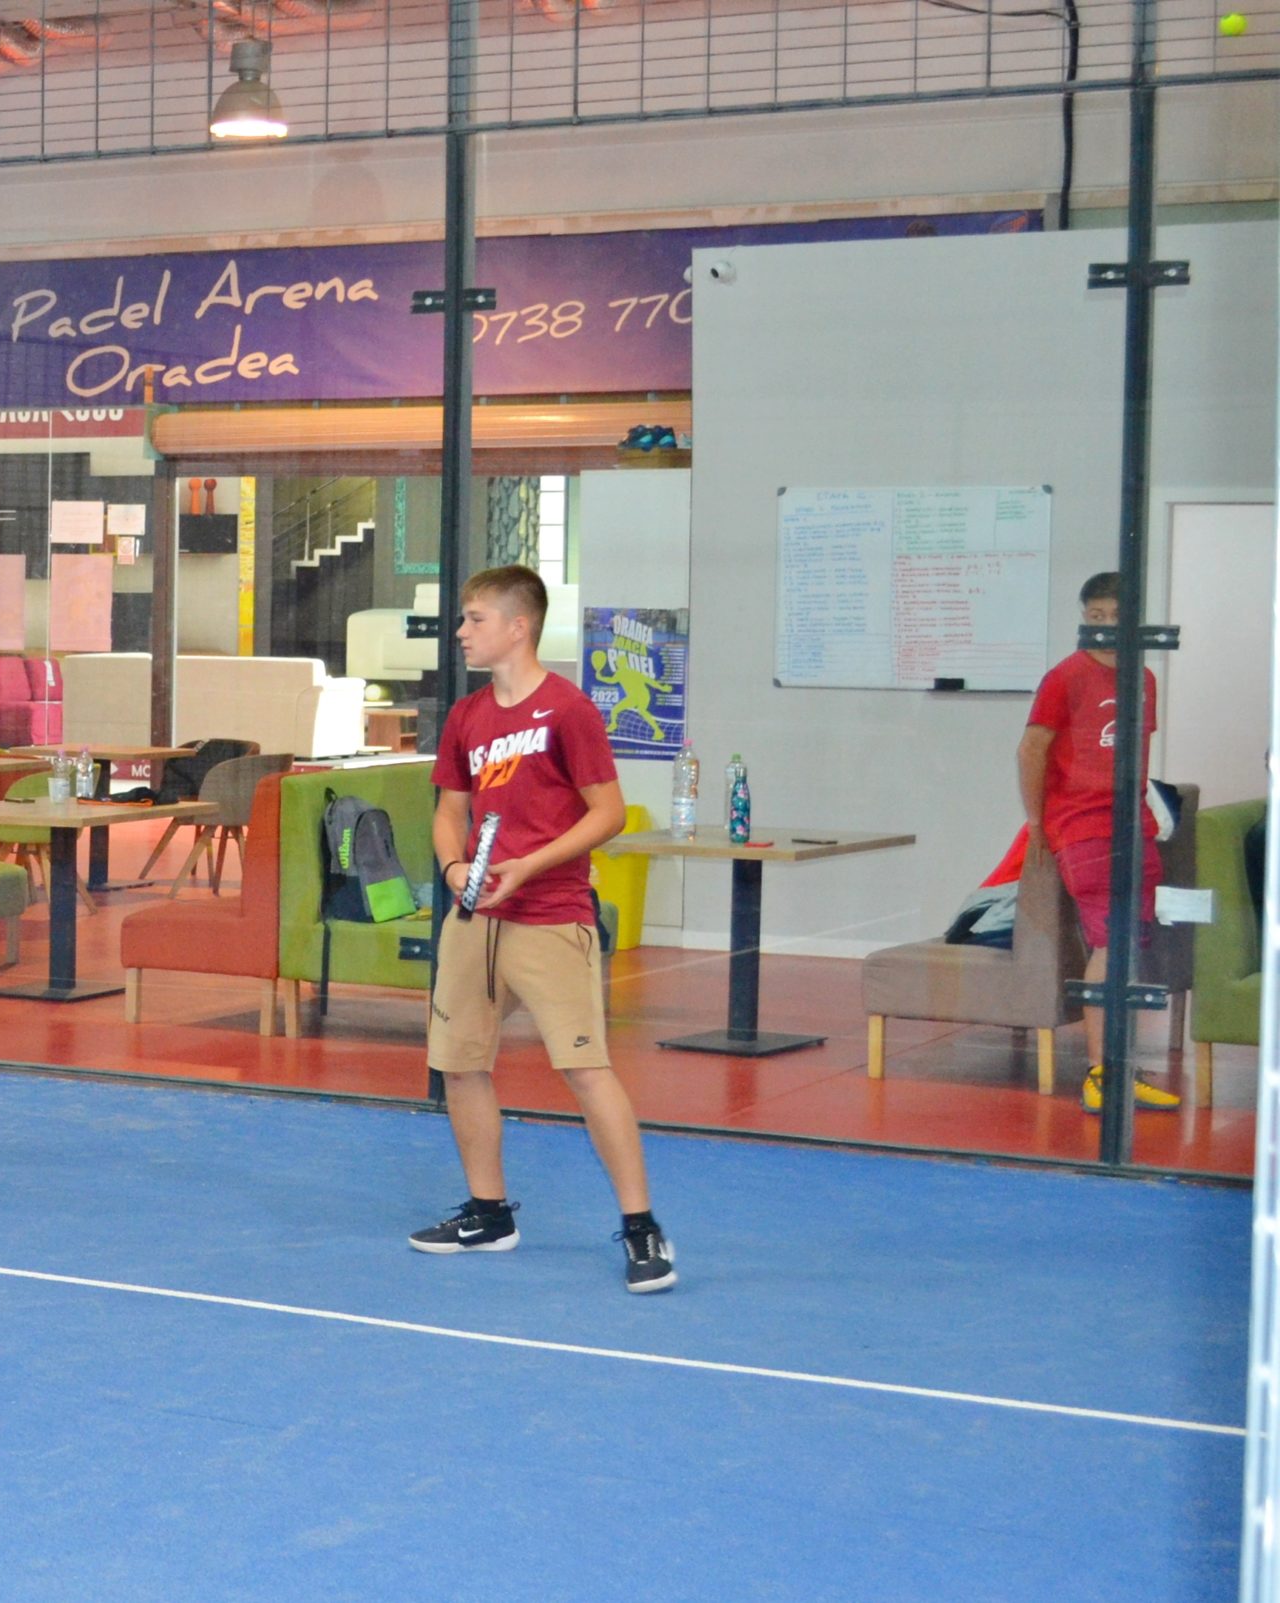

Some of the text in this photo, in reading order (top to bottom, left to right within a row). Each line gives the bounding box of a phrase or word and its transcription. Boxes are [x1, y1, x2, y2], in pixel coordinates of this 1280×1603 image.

[11, 260, 379, 342] Padel Arena
[66, 325, 300, 398] Oradea
[613, 615, 653, 646] ORADEA
[590, 690, 619, 704] 2023
